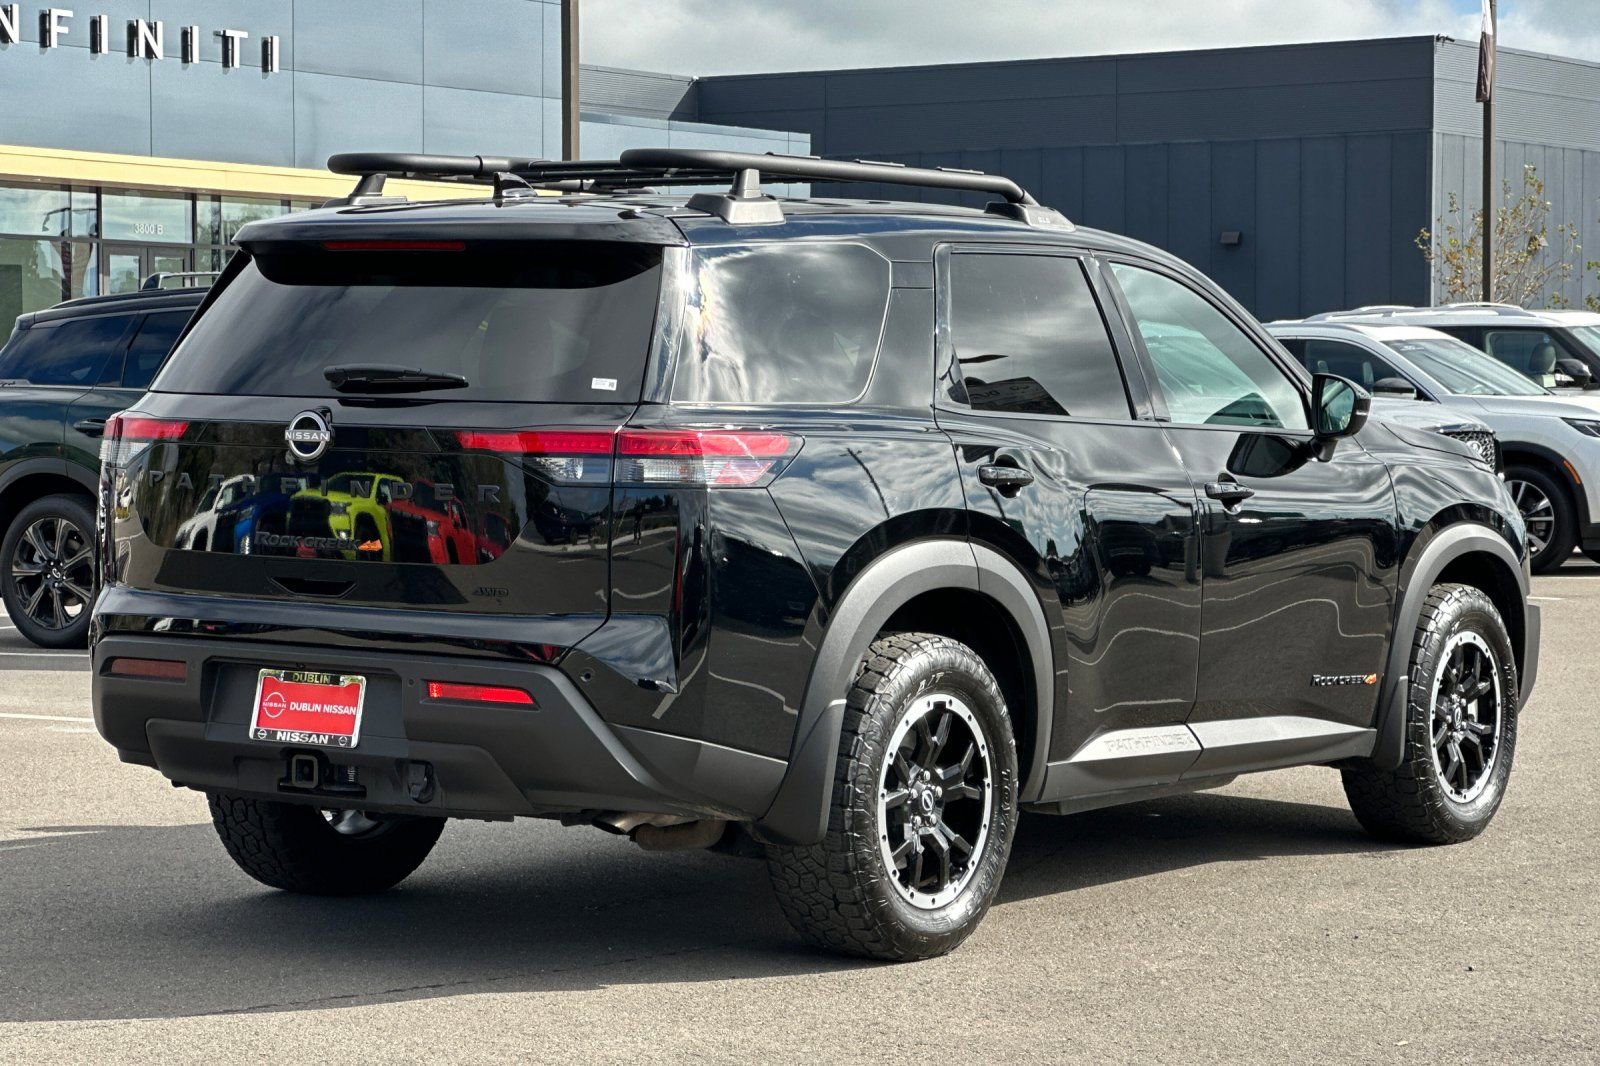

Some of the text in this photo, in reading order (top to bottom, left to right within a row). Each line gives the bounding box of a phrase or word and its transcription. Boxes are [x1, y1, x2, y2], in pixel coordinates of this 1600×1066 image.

[134, 223, 164, 235] 3800 B
[285, 431, 329, 441] NISSAN
[149, 470, 501, 503] PATHFINDER
[254, 531, 301, 547] ROCK
[471, 586, 509, 598] AWD
[292, 672, 331, 684] DUBLIN
[290, 701, 357, 716] DUBLIN NISSAN
[276, 730, 329, 744] NISSAN
